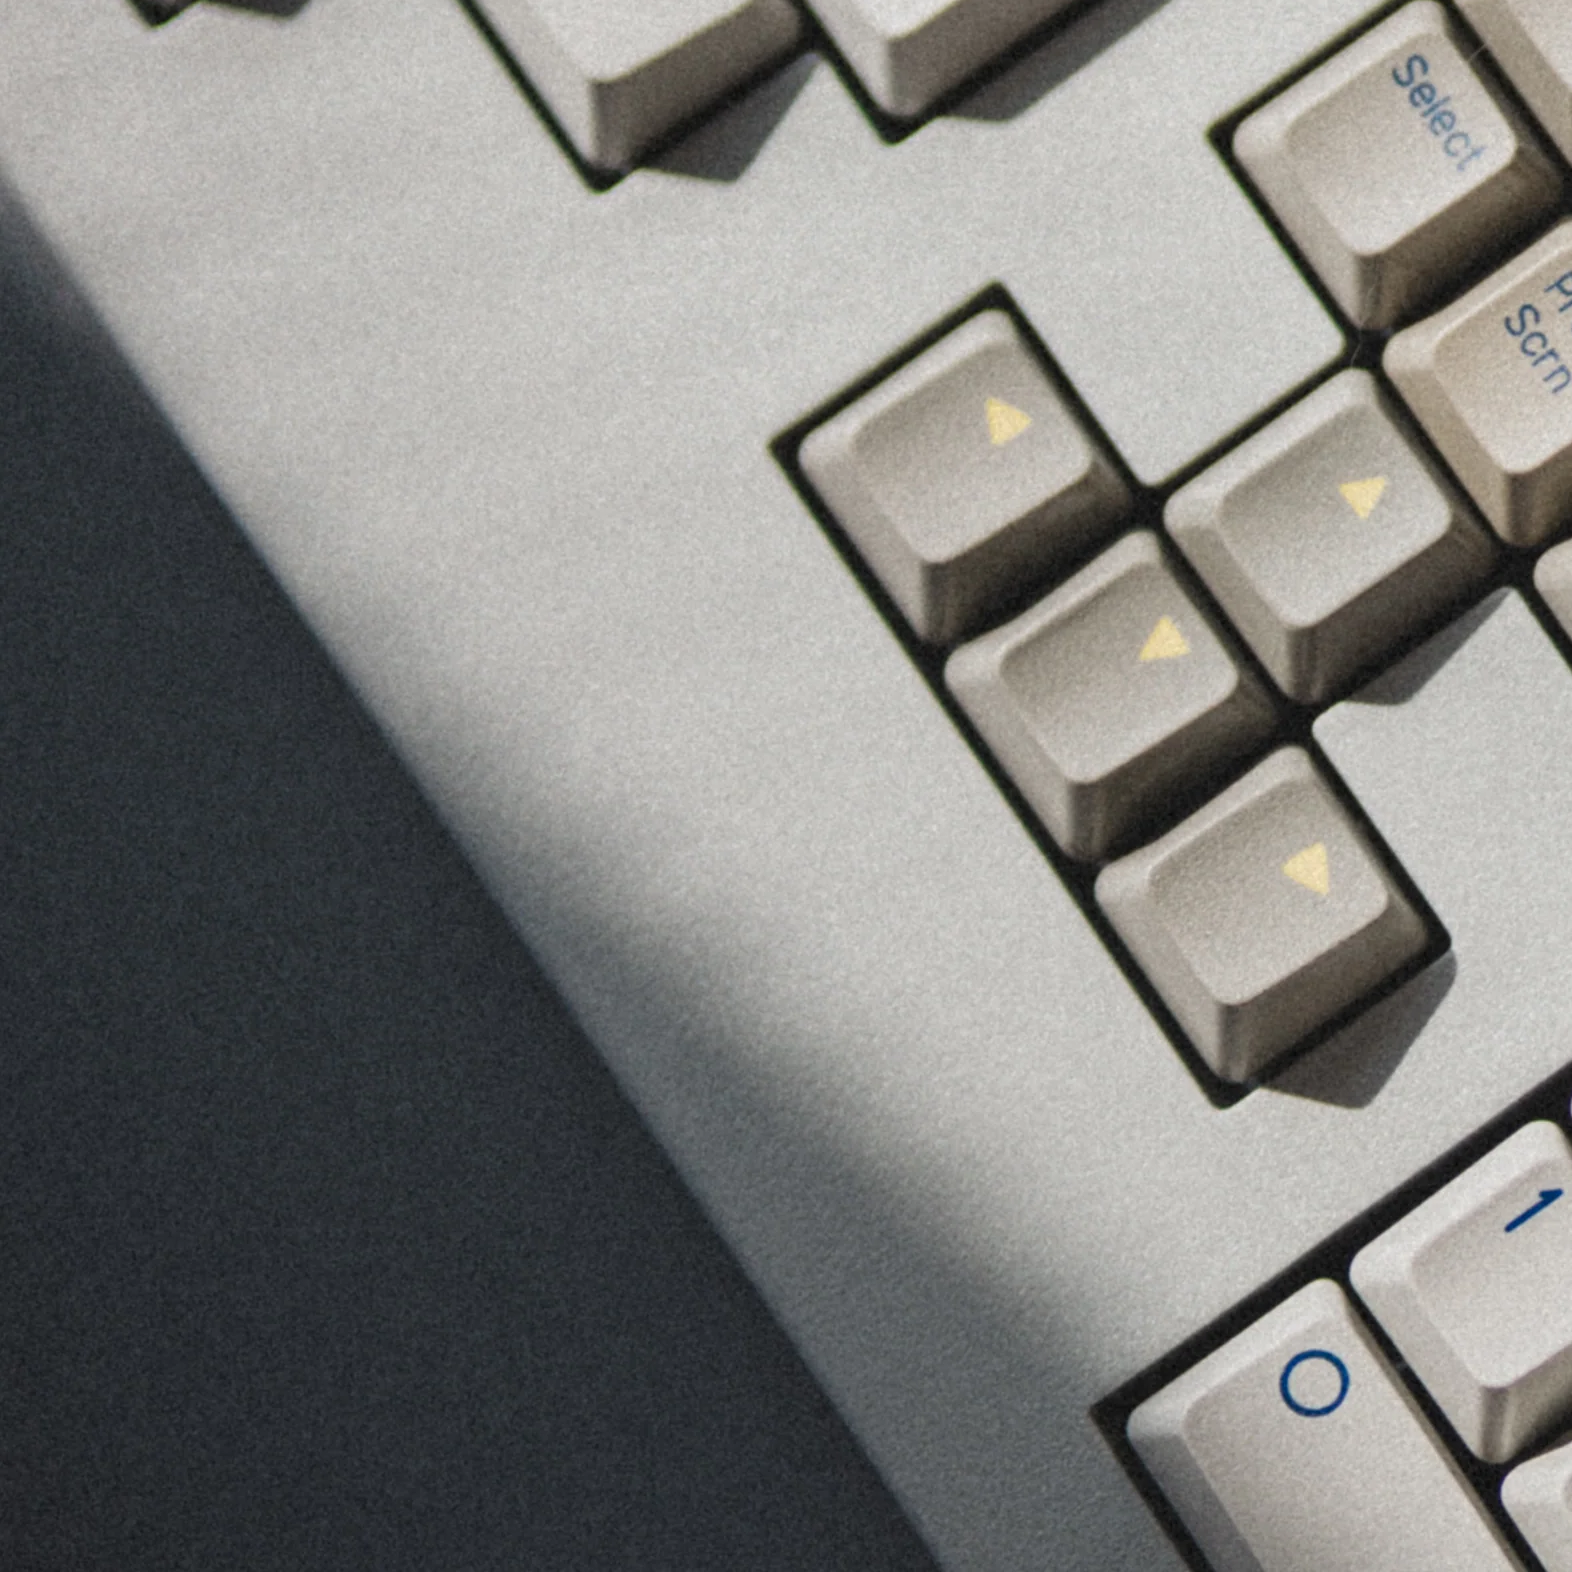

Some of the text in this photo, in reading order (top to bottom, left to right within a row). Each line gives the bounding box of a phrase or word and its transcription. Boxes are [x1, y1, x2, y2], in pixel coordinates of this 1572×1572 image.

[1391, 53, 1488, 172] Select
[1502, 305, 1572, 396] Scrn
[1504, 1189, 1564, 1233] 1
